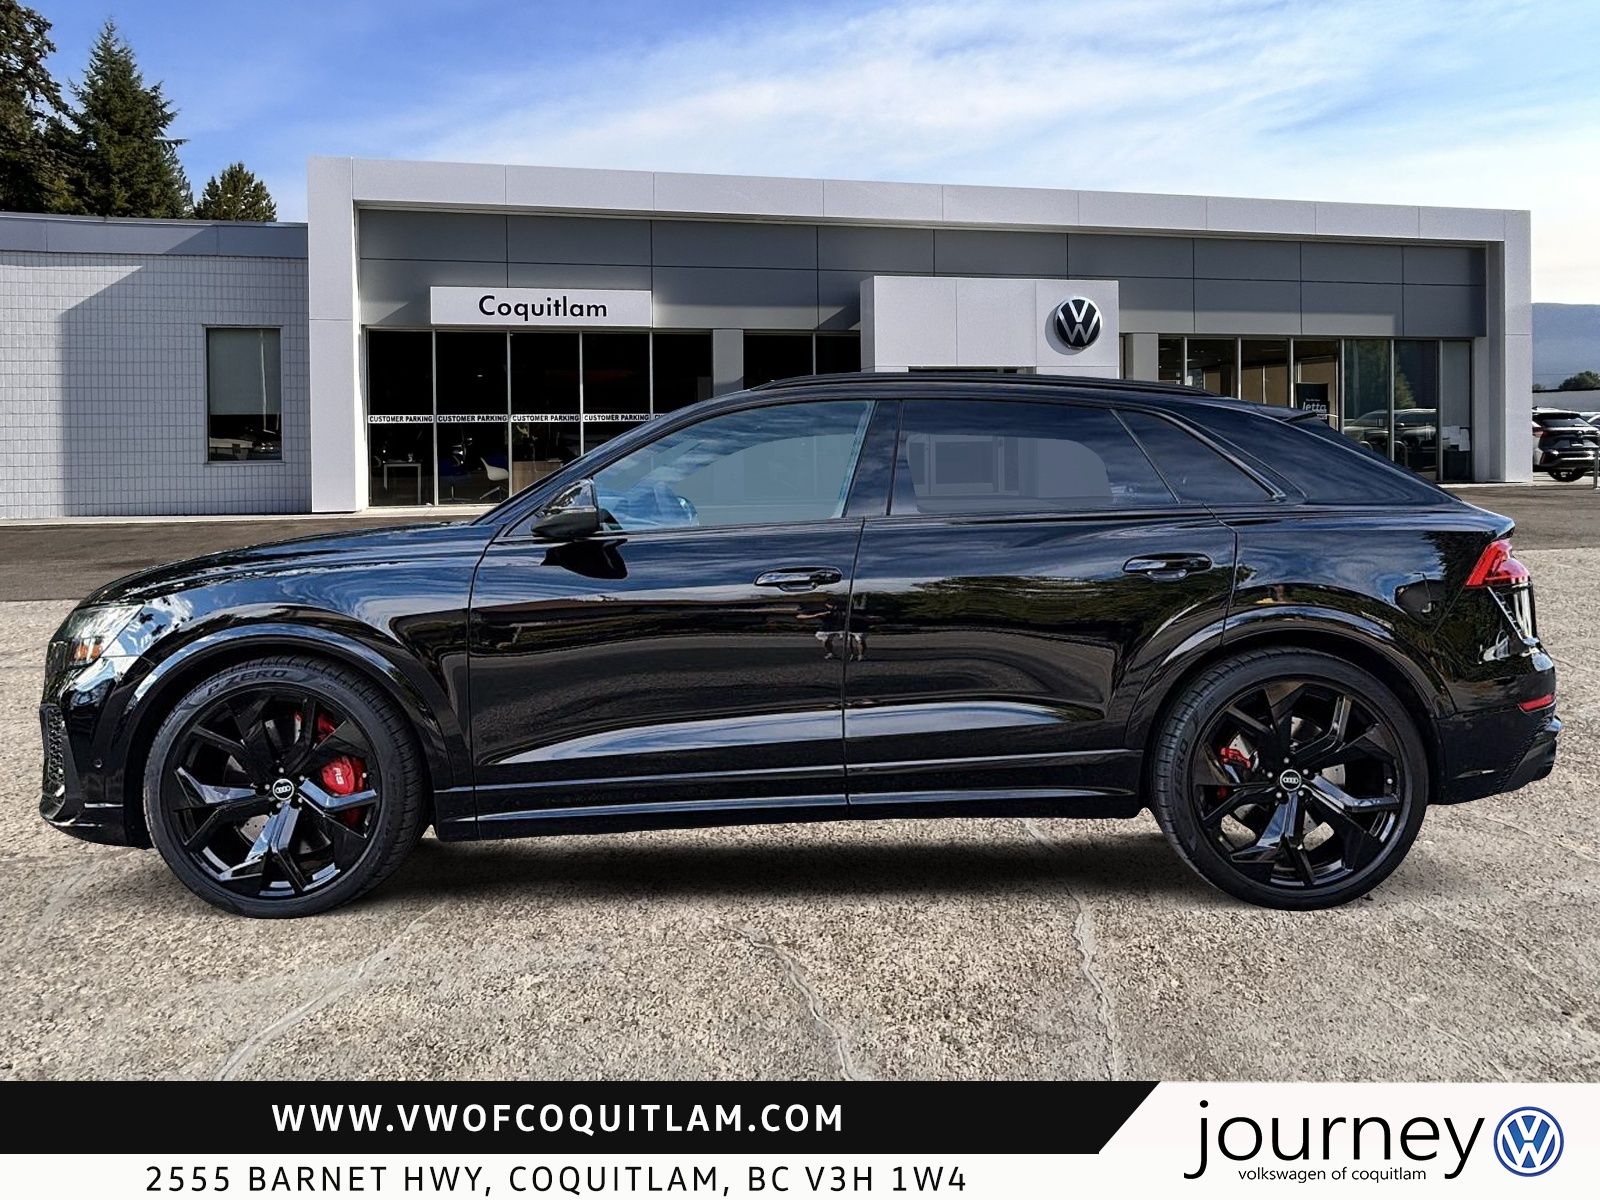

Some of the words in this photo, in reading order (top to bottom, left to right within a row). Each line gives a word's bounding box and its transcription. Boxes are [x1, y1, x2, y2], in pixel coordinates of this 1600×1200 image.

[478, 294, 608, 322] Coquitlam
[369, 415, 404, 423] CUSTOMER
[404, 415, 433, 423] PARKING
[512, 414, 549, 422] CUSTOMER
[550, 414, 580, 422] PARKING
